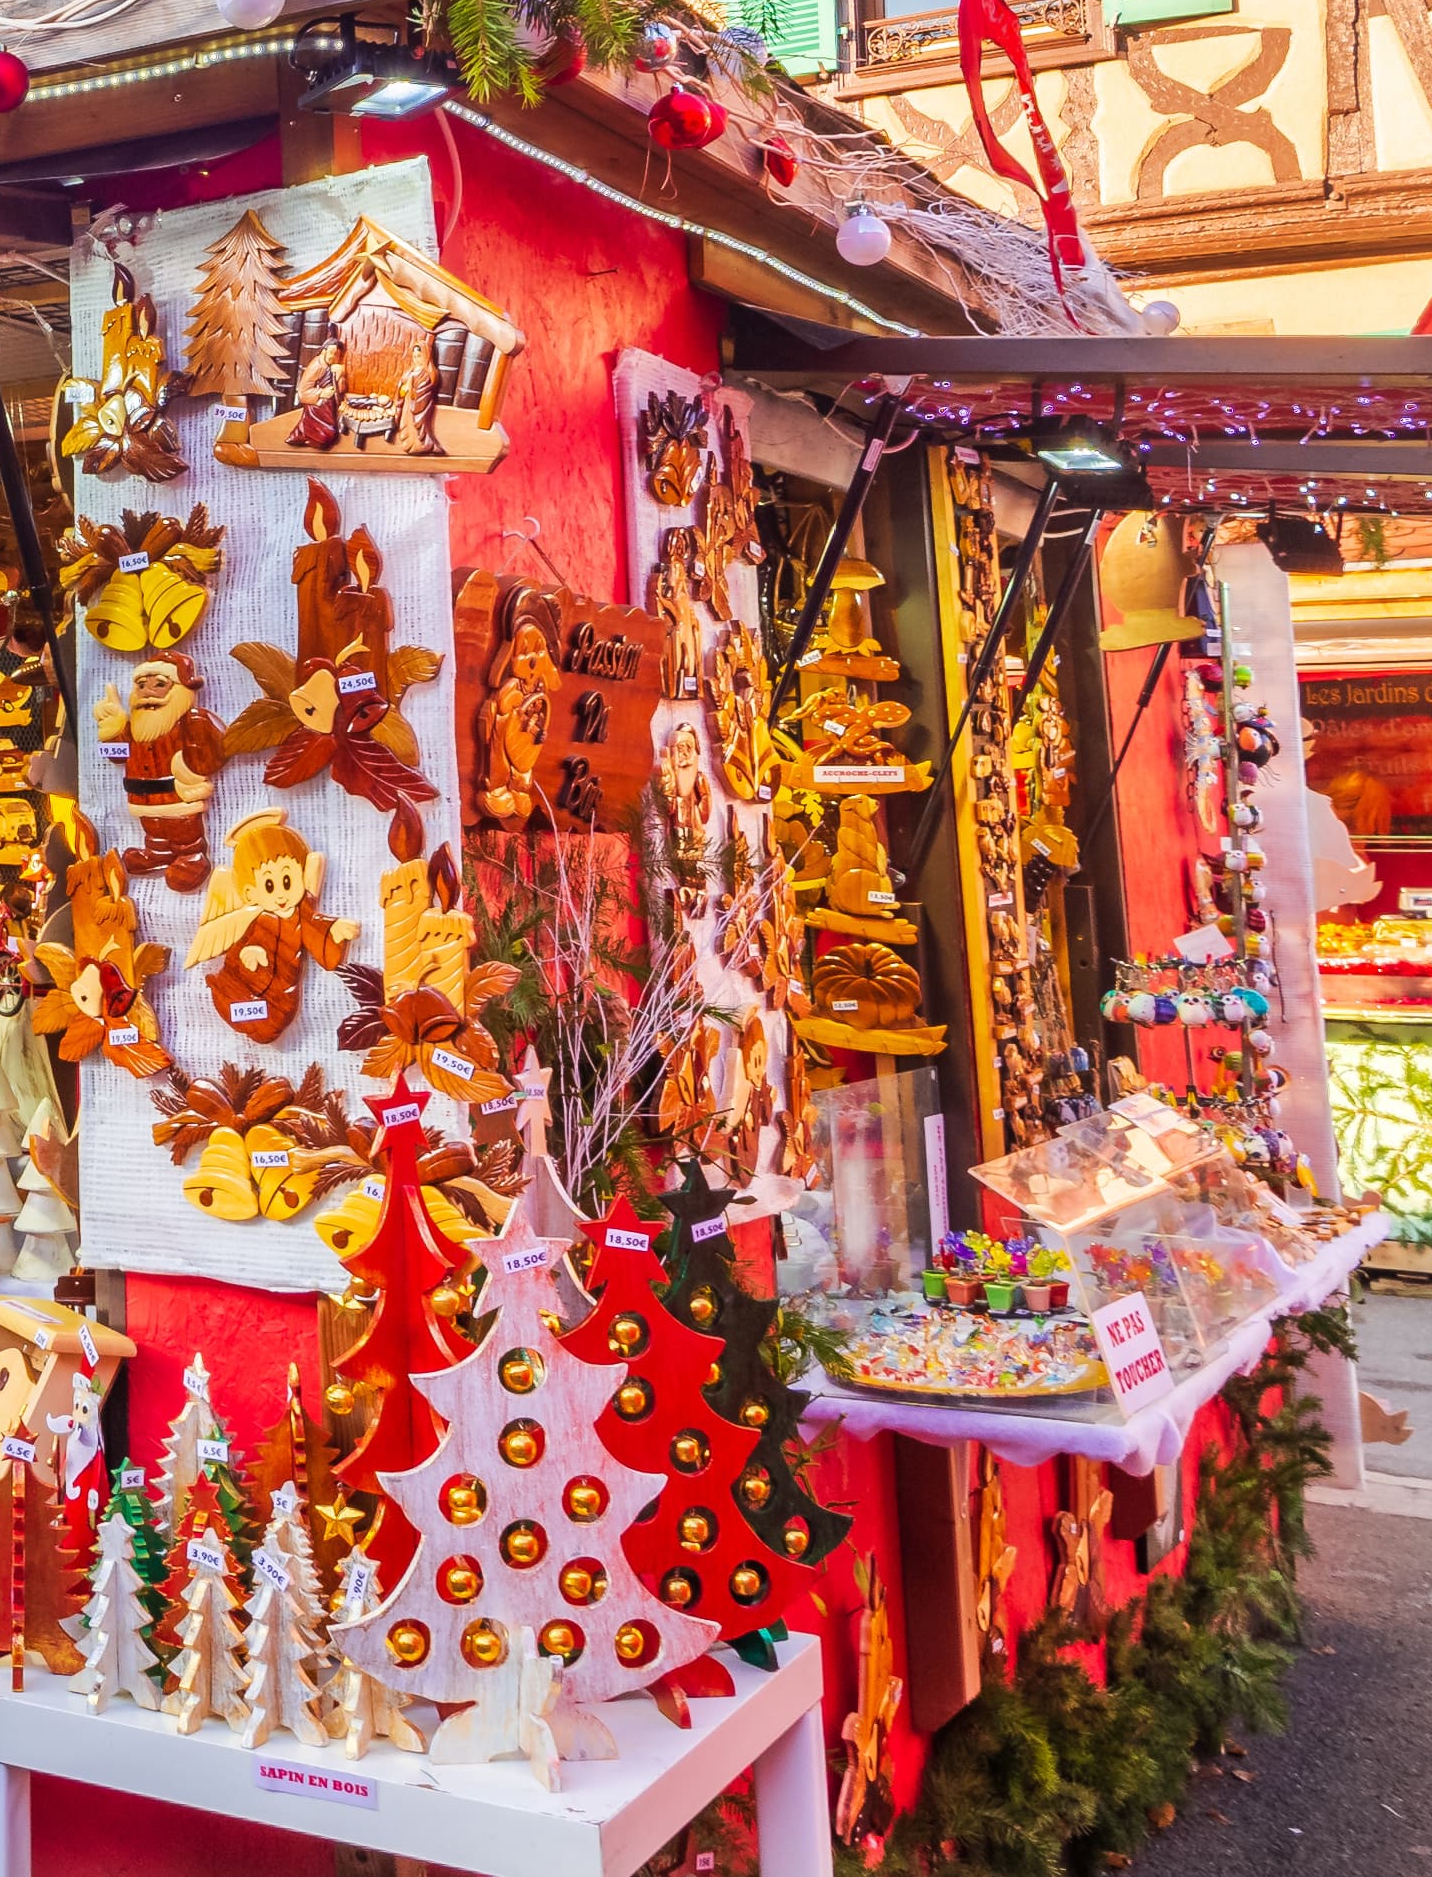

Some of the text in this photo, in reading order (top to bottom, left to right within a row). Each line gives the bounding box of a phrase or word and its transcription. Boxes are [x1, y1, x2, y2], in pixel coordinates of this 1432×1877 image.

[214, 408, 245, 420] 39,50€
[121, 555, 147, 568] 16,50€
[571, 621, 643, 681] Passion
[341, 677, 374, 690] 24,50€
[1346, 678, 1419, 708] Jardins
[99, 746, 128, 755] 19,50€
[822, 769, 898, 778] ACCROCHE-CLEFS
[234, 1006, 265, 1017] 19,50€
[111, 1033, 136, 1043] 19,50€
[435, 1053, 471, 1075] 19,50€
[483, 1096, 515, 1111] 18,50€
[385, 1107, 419, 1124] 18,50€
[254, 1153, 286, 1164] 16,50€
[695, 1223, 723, 1237] 18,50€
[609, 1233, 647, 1248] 18,50€
[507, 1253, 546, 1270] 18,50€
[1108, 1312, 1145, 1345] NE PAS
[1115, 1348, 1166, 1392] TOUCHER
[6, 1443, 31, 1459] 6,5€
[203, 1446, 222, 1457] 6,5€
[126, 1475, 140, 1485] 5€
[275, 1497, 289, 1509] 5€
[191, 1549, 219, 1566] 3,90€
[257, 1556, 285, 1585] 3,90€
[351, 1570, 367, 1603] ,90€
[260, 1765, 368, 1797] SAPIN EN BOIS
